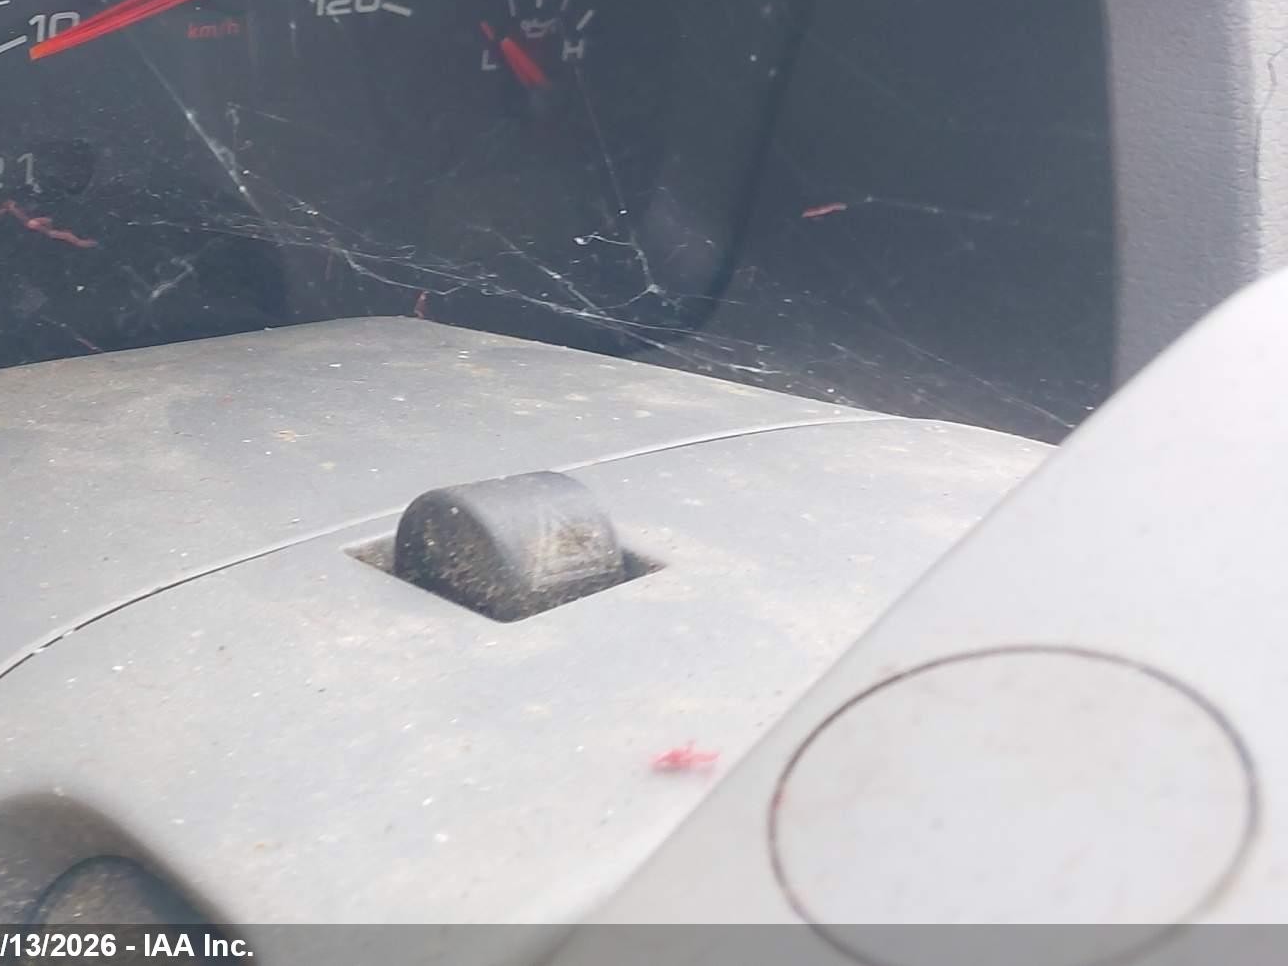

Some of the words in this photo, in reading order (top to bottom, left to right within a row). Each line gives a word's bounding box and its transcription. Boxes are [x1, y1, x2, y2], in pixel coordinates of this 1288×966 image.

[28, 11, 80, 43] 10
[482, 50, 497, 71] L
[562, 39, 585, 62] H
